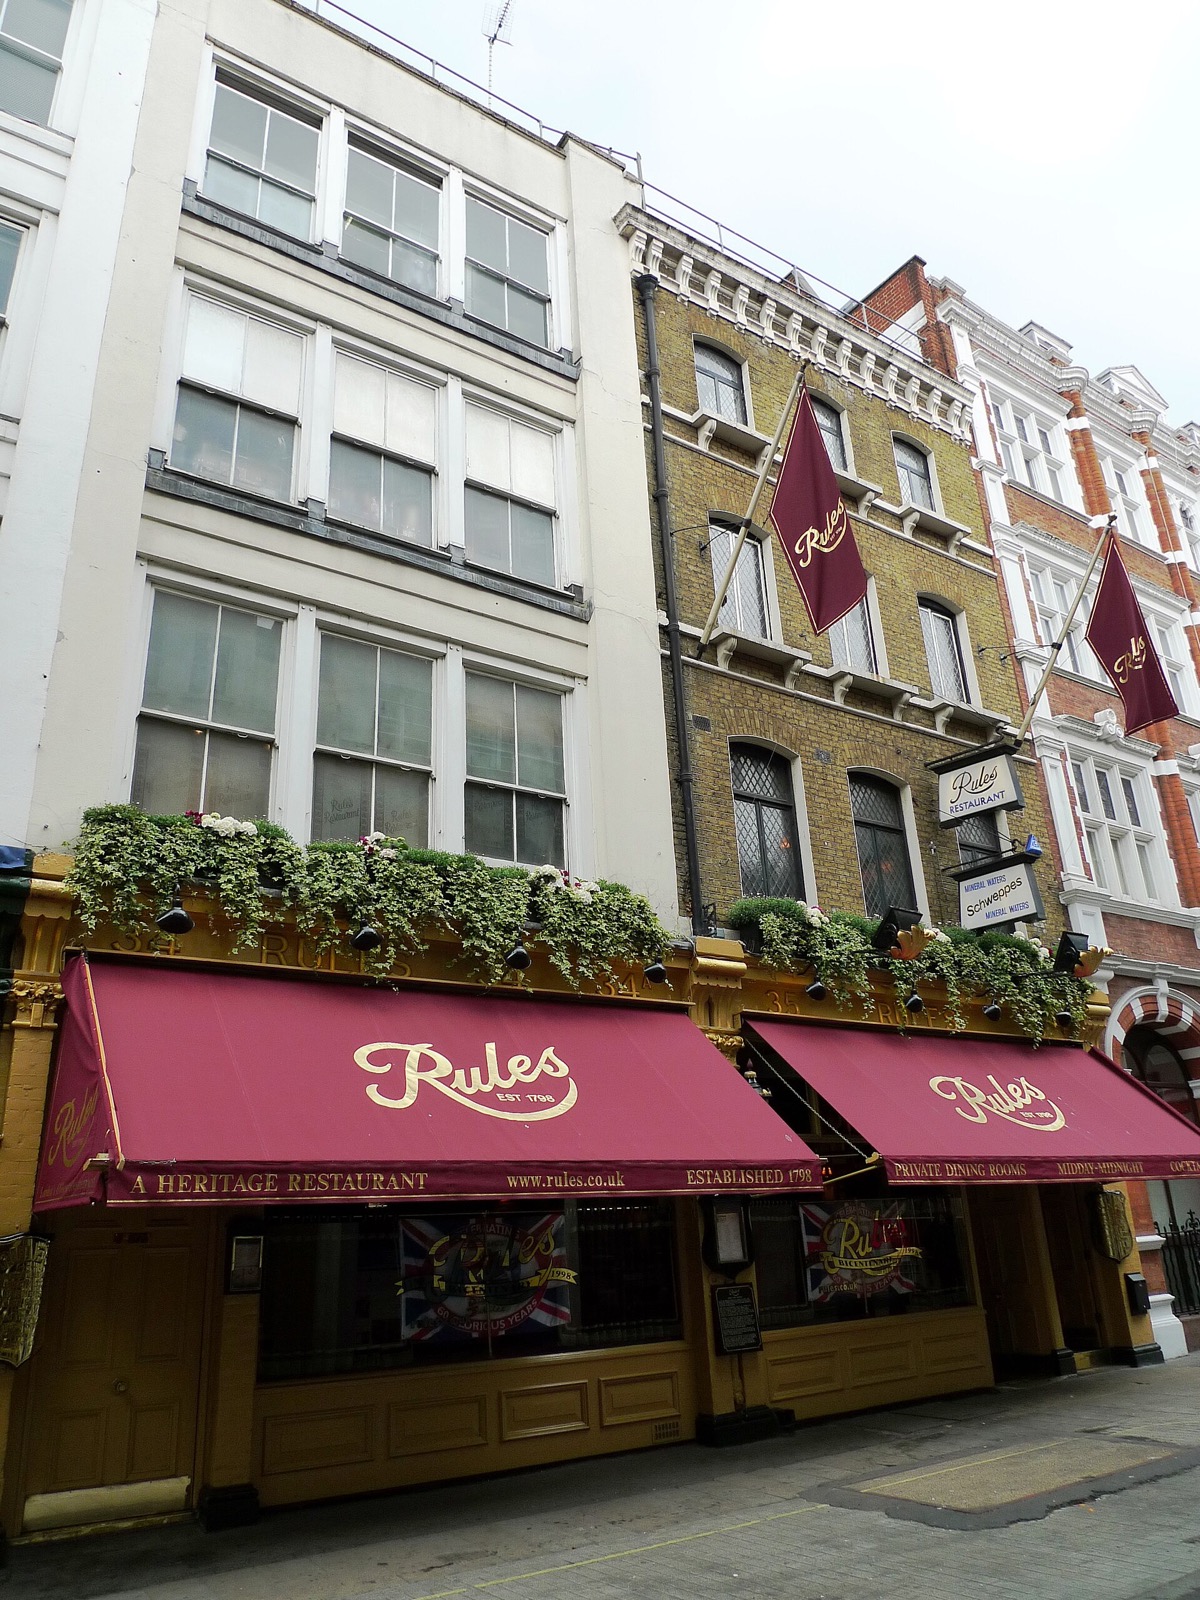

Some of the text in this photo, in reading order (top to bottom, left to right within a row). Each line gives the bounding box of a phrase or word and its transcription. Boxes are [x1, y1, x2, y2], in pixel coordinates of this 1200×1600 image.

[795, 496, 847, 568] Rules
[950, 765, 998, 804] Rules
[949, 790, 1006, 815] RESTAURANT
[964, 874, 1007, 893] MINERAL WATERS
[966, 877, 1023, 917] Schweppes
[985, 901, 1030, 920] MINERAL WATERS
[765, 989, 799, 1014] 35
[353, 1041, 578, 1122] Rules
[496, 1093, 556, 1103] EST 1798
[929, 1074, 1066, 1132] Rules
[686, 1169, 813, 1185] ESTABLISHED 1798
[895, 1163, 1027, 1177] PRIVATE DINING ROOMS
[1056, 1161, 1144, 1175] MIDDAY-MIDNIGHT
[130, 1172, 428, 1194] A HERITAGE RESTAURANT
[506, 1171, 626, 1188] www.rules.co.uk
[551, 1269, 572, 1281] 1998
[507, 1298, 538, 1325] YEARS
